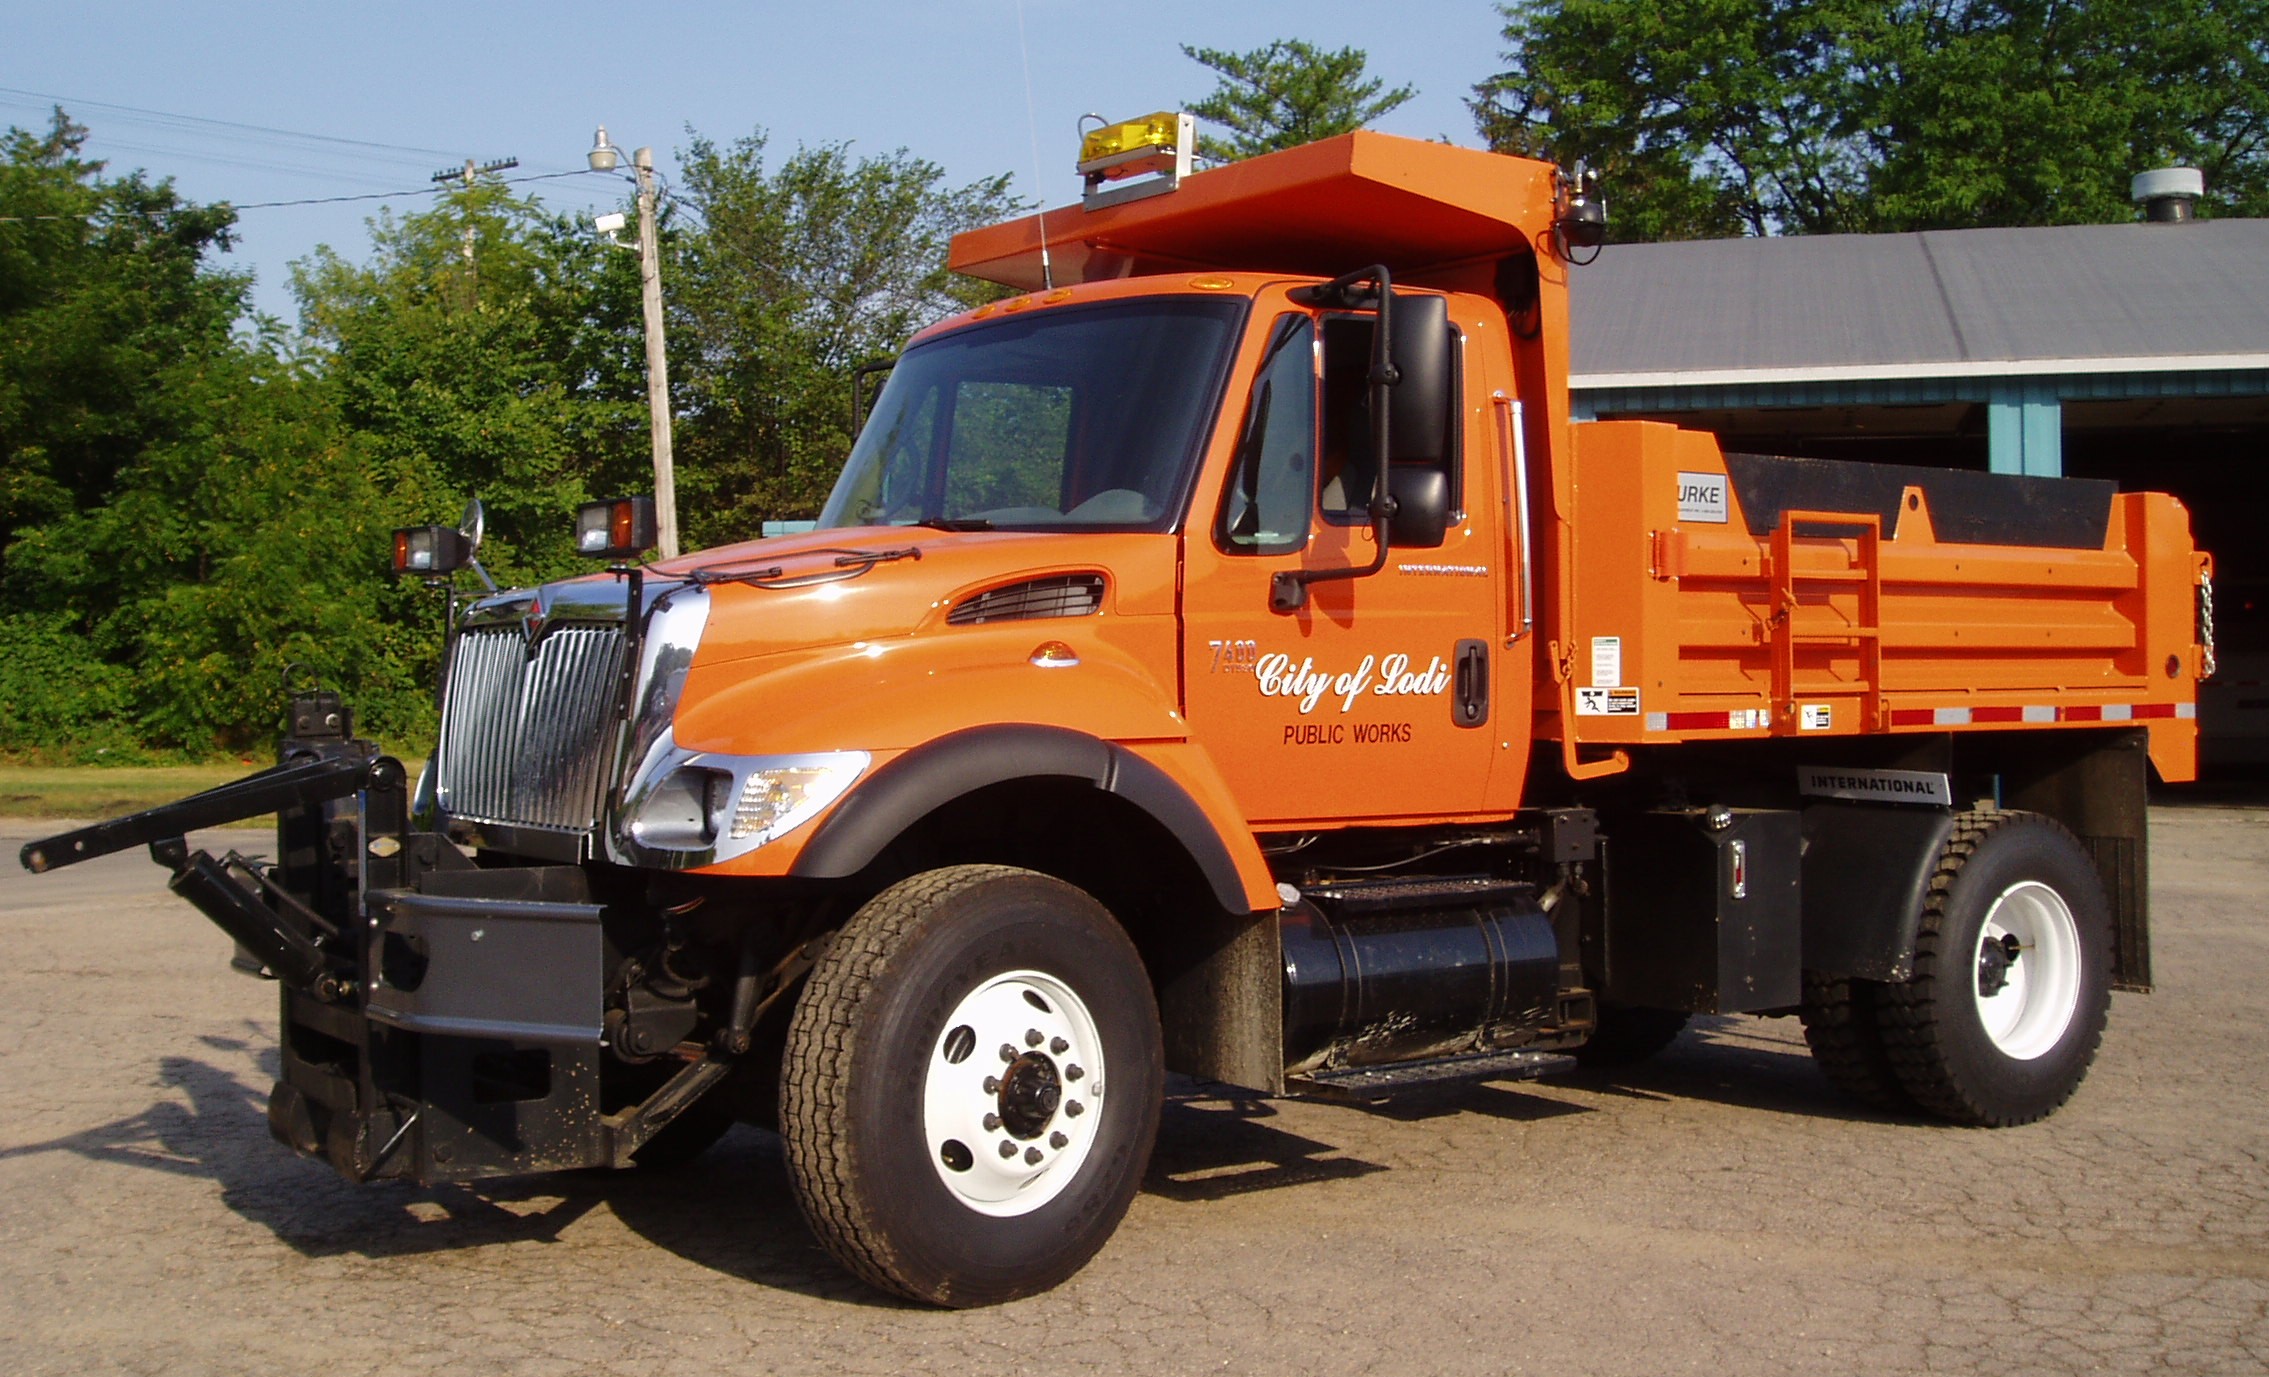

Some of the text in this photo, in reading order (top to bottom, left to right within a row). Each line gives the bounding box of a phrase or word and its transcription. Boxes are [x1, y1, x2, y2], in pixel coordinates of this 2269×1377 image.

[1255, 653, 1451, 714] City of Lodi
[1283, 722, 1413, 745] PUBLIC WORKS
[1810, 775, 1935, 795] INTERNATIONAL
